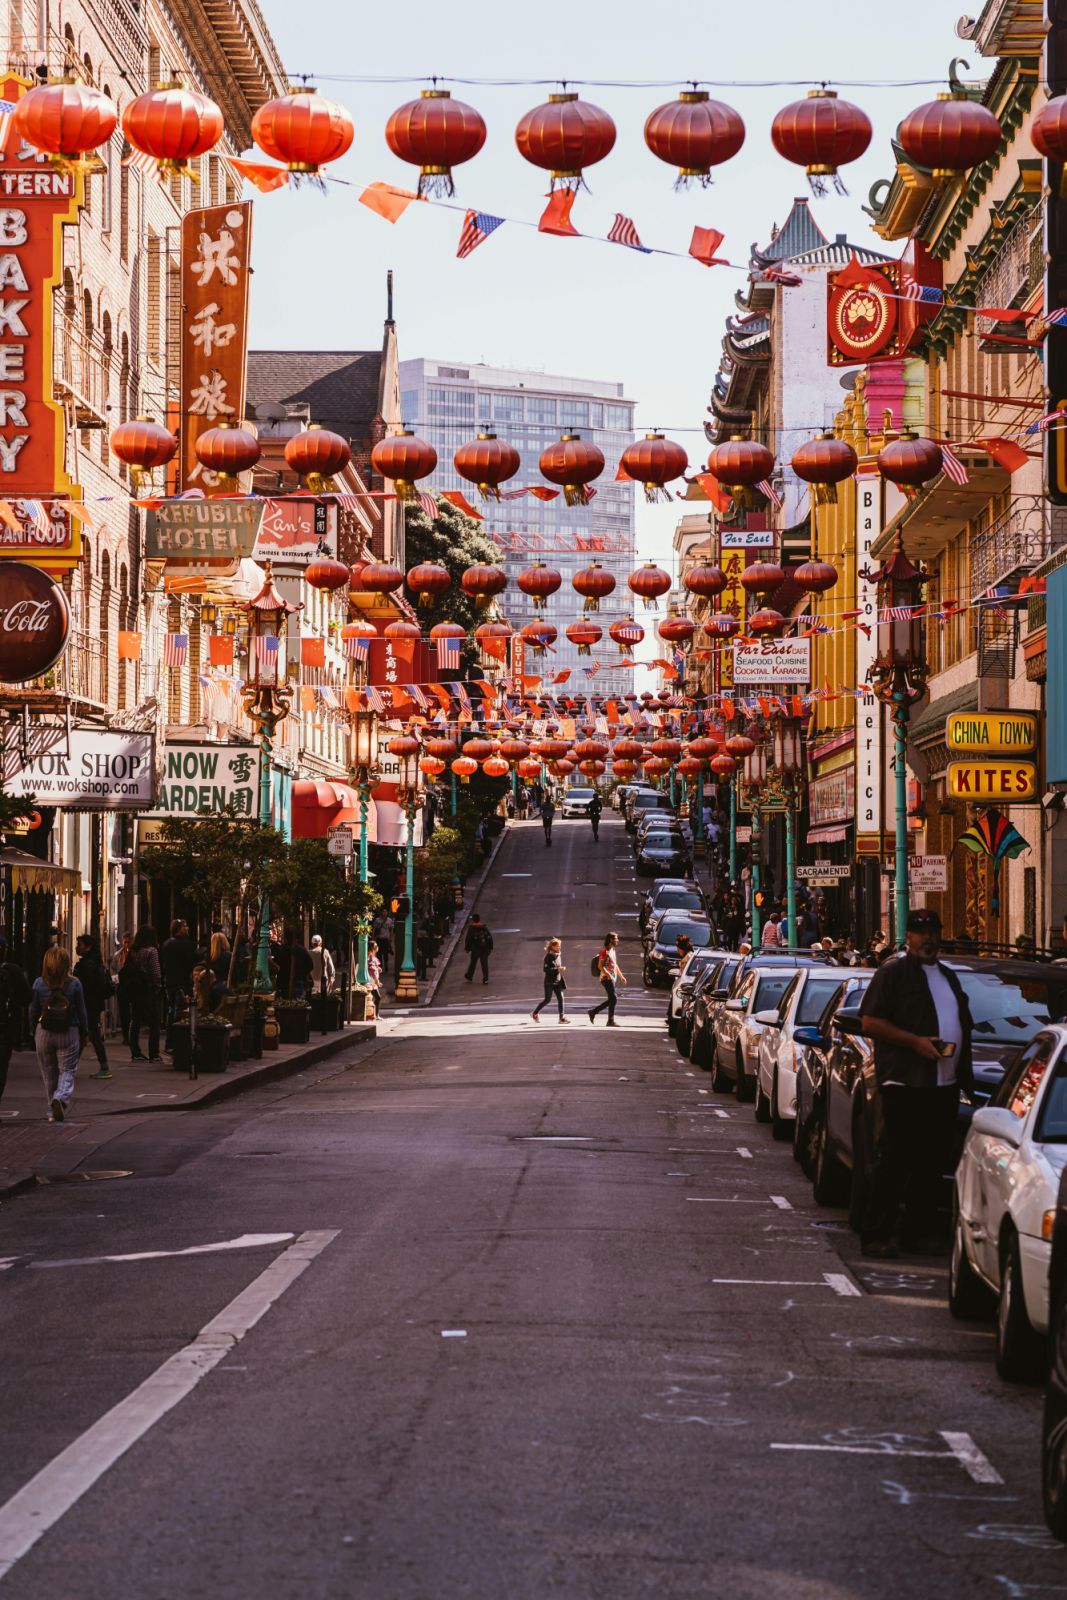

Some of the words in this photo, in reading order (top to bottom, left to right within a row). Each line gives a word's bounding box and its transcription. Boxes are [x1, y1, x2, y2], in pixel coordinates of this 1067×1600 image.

[2, 173, 69, 195] TERN
[0, 208, 30, 472] BAKERY
[155, 504, 256, 524] REPUBLIC
[259, 504, 312, 540] Kan's
[156, 528, 239, 550] HOTEL
[725, 533, 742, 544] Far
[745, 532, 770, 544] East
[864, 492, 873, 578] Bank
[3, 600, 52, 632] Cola
[760, 641, 792, 656] East
[954, 720, 989, 744] CHINA
[998, 721, 1032, 745] TOWN
[863, 668, 874, 821] America
[81, 752, 141, 779] SHOP
[163, 751, 219, 780] NOW
[21, 778, 139, 796] www.wokshop.com
[957, 769, 1028, 792] KITES
[797, 866, 849, 877] SACRAMENTO
[911, 856, 922, 867] NO
[922, 858, 946, 866] PARKING
